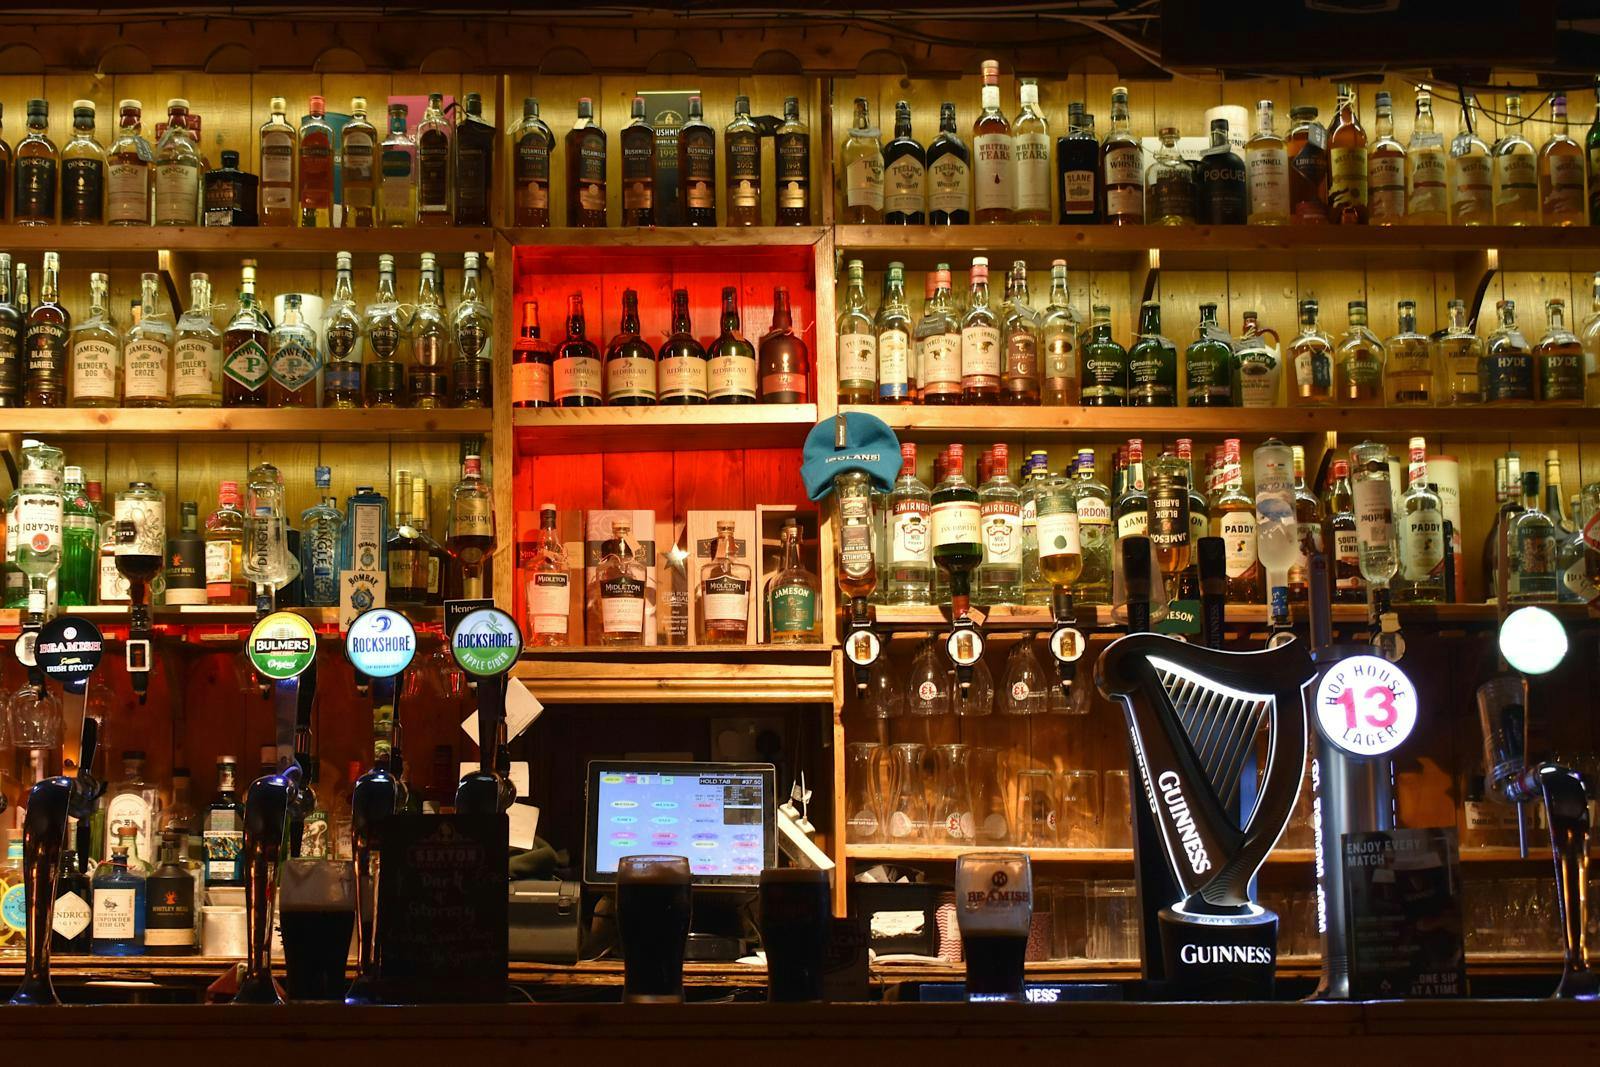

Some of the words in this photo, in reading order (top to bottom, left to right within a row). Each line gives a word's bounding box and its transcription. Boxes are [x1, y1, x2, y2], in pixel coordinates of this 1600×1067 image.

[656, 128, 680, 137] USHMI
[520, 148, 547, 156] BUSHMILLS
[624, 148, 652, 156] BUSHMILLS
[687, 147, 714, 156] BUSHMILLS
[979, 151, 1011, 161] TEARS
[1016, 151, 1048, 160] TEARS
[21, 159, 50, 169] DINGLE
[68, 158, 97, 169] DINGLE
[1110, 160, 1144, 170] WHISTLE
[111, 167, 139, 177] DINGLE
[161, 167, 189, 177] DINGLE
[892, 165, 922, 176] TEELING
[934, 164, 964, 176] TEELING
[1067, 174, 1092, 183] SLANE
[1204, 170, 1246, 182] POGUES
[26, 326, 62, 337] JAMESON
[31, 351, 53, 359] BLACK
[76, 345, 110, 355] JAMESON
[128, 345, 163, 355] JAMESON
[29, 361, 55, 370] BARREL
[77, 362, 108, 370] BLENDER'S
[131, 362, 160, 370] COOPER'S
[247, 358, 261, 373] P
[1498, 357, 1527, 368] HYDE
[1548, 357, 1578, 368] HYDE
[134, 369, 155, 377] CROZE
[181, 368, 196, 376] SAFE
[896, 501, 931, 512] SMIRNOF
[1154, 499, 1180, 508] BARREL
[981, 504, 1019, 515] SMIRNOFF
[1155, 510, 1178, 518] BLACK
[1124, 514, 1148, 528] JAME
[1225, 525, 1254, 534] PADDY
[1411, 523, 1440, 532] PADDY
[258, 519, 269, 567] DINGLE
[316, 516, 328, 570] DINGLE
[842, 553, 871, 561] BUSHMILLS
[348, 574, 379, 587] BOMBAY
[537, 575, 566, 584] MIDLETON
[605, 583, 641, 592] MIDLETON
[710, 582, 742, 591] MIDLETON
[775, 587, 809, 599] JAMESON
[451, 605, 480, 613] Henne
[256, 639, 309, 651] BULMERS
[353, 634, 411, 653] ROCKSHORE
[457, 632, 514, 649] ROCKSHORE
[39, 641, 101, 654] BEAMISH
[267, 659, 296, 670] Original
[462, 652, 487, 671] APPLE
[486, 652, 509, 671] CIDER
[47, 664, 67, 673] IRISH
[68, 664, 93, 672] STOUT
[1325, 672, 1346, 705] HOP
[1354, 665, 1406, 701] HOUSE
[1336, 686, 1398, 728] 13
[1342, 724, 1398, 746] LAGER
[1157, 770, 1212, 875] GUINNESS
[1347, 841, 1382, 854] ENJOY
[1385, 839, 1421, 852] EVERY
[1347, 854, 1384, 867] MATCH
[1180, 944, 1271, 964] GUINNESS
[1440, 973, 1457, 983] SIP
[1025, 988, 1061, 1002] NESS
